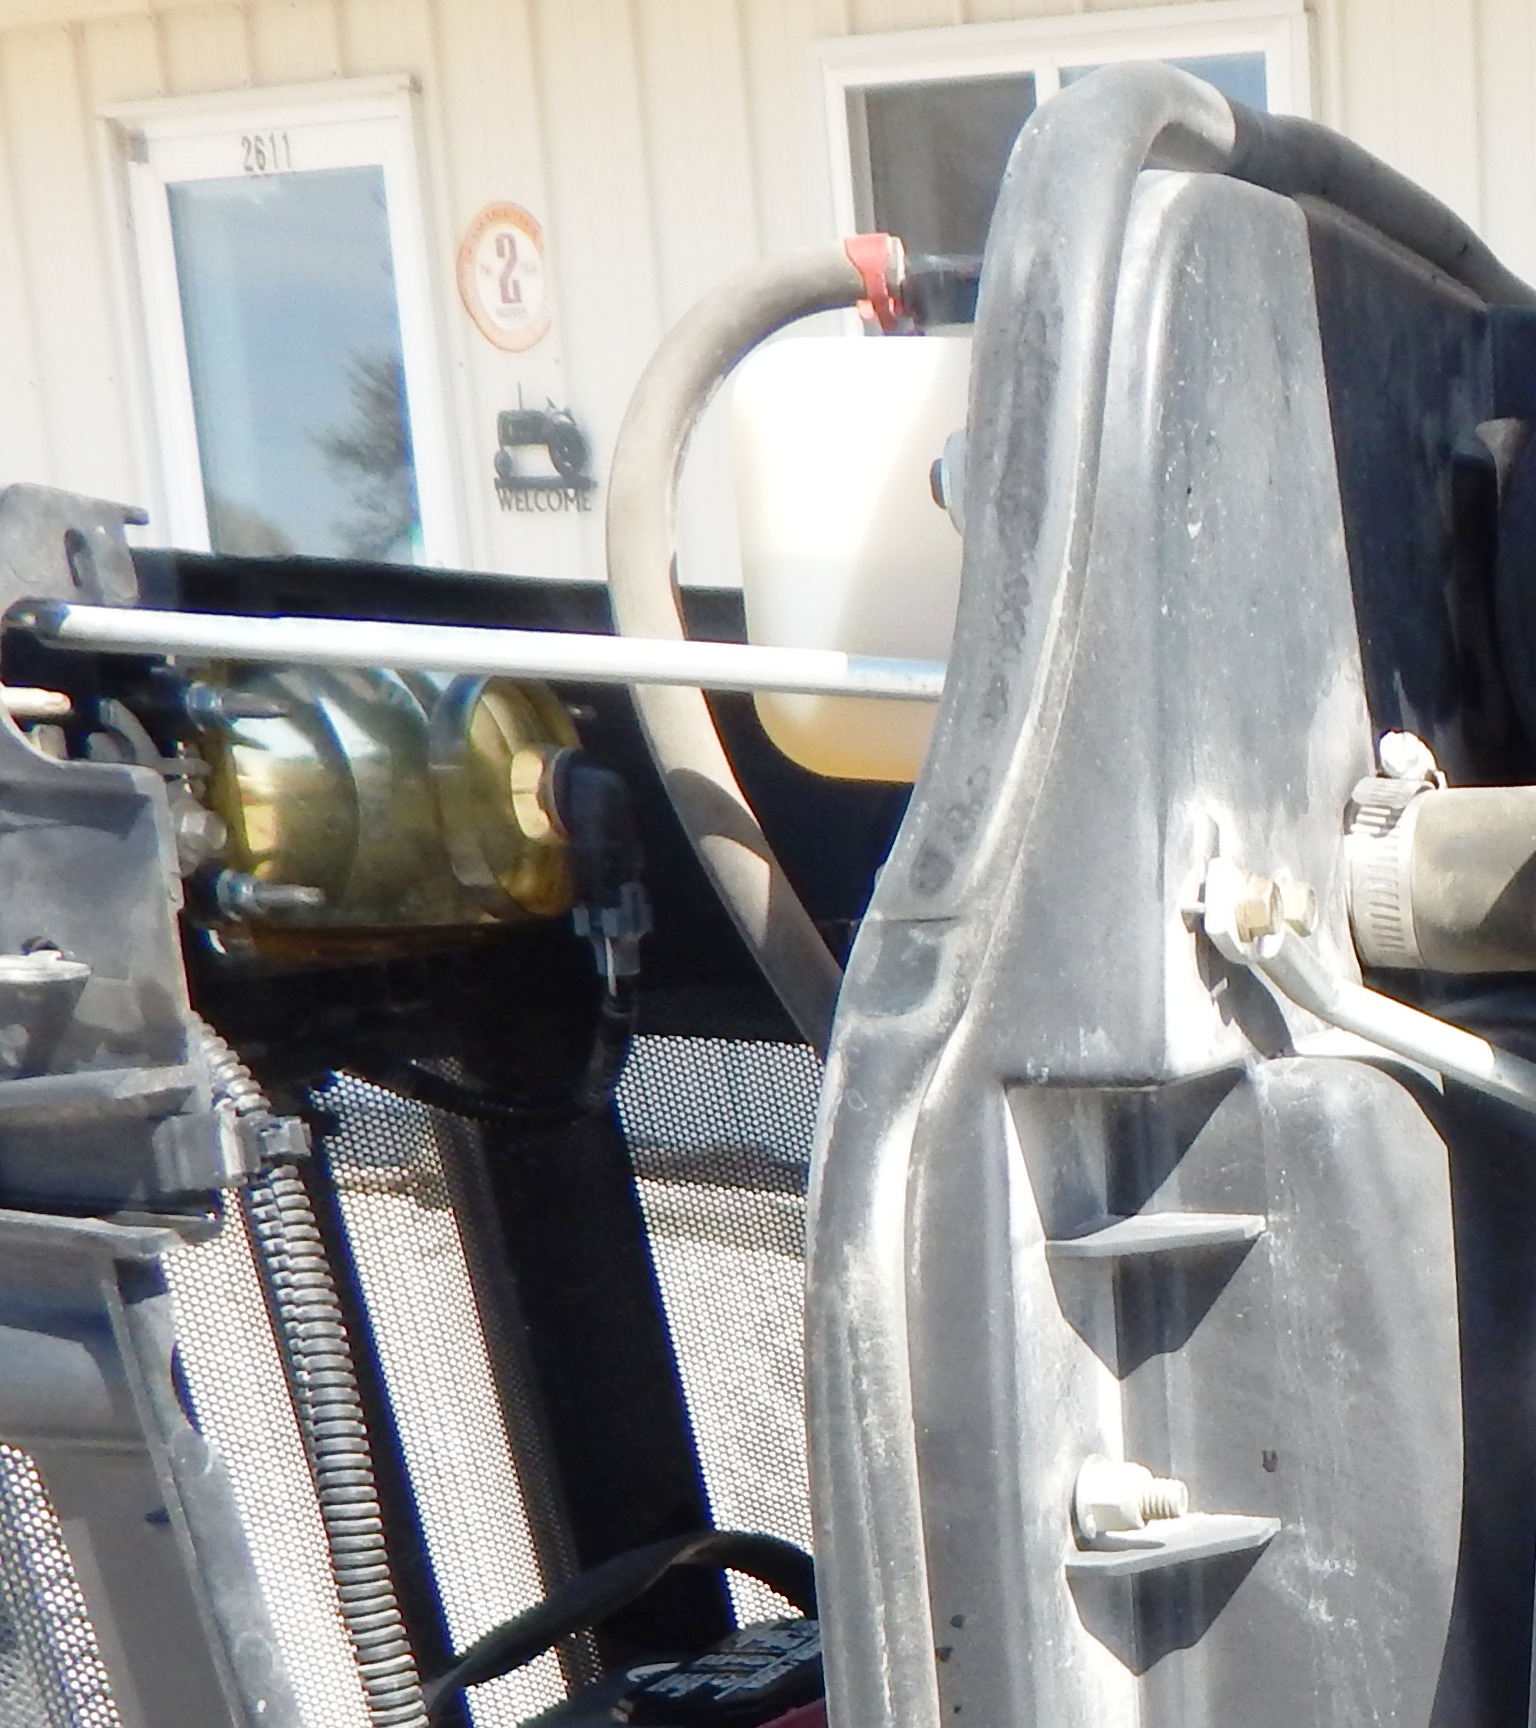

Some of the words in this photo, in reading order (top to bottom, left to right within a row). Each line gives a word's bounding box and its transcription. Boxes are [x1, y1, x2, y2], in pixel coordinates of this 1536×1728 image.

[241, 132, 293, 172] 2611
[495, 233, 522, 304] 2
[496, 487, 592, 512] WELCOME
